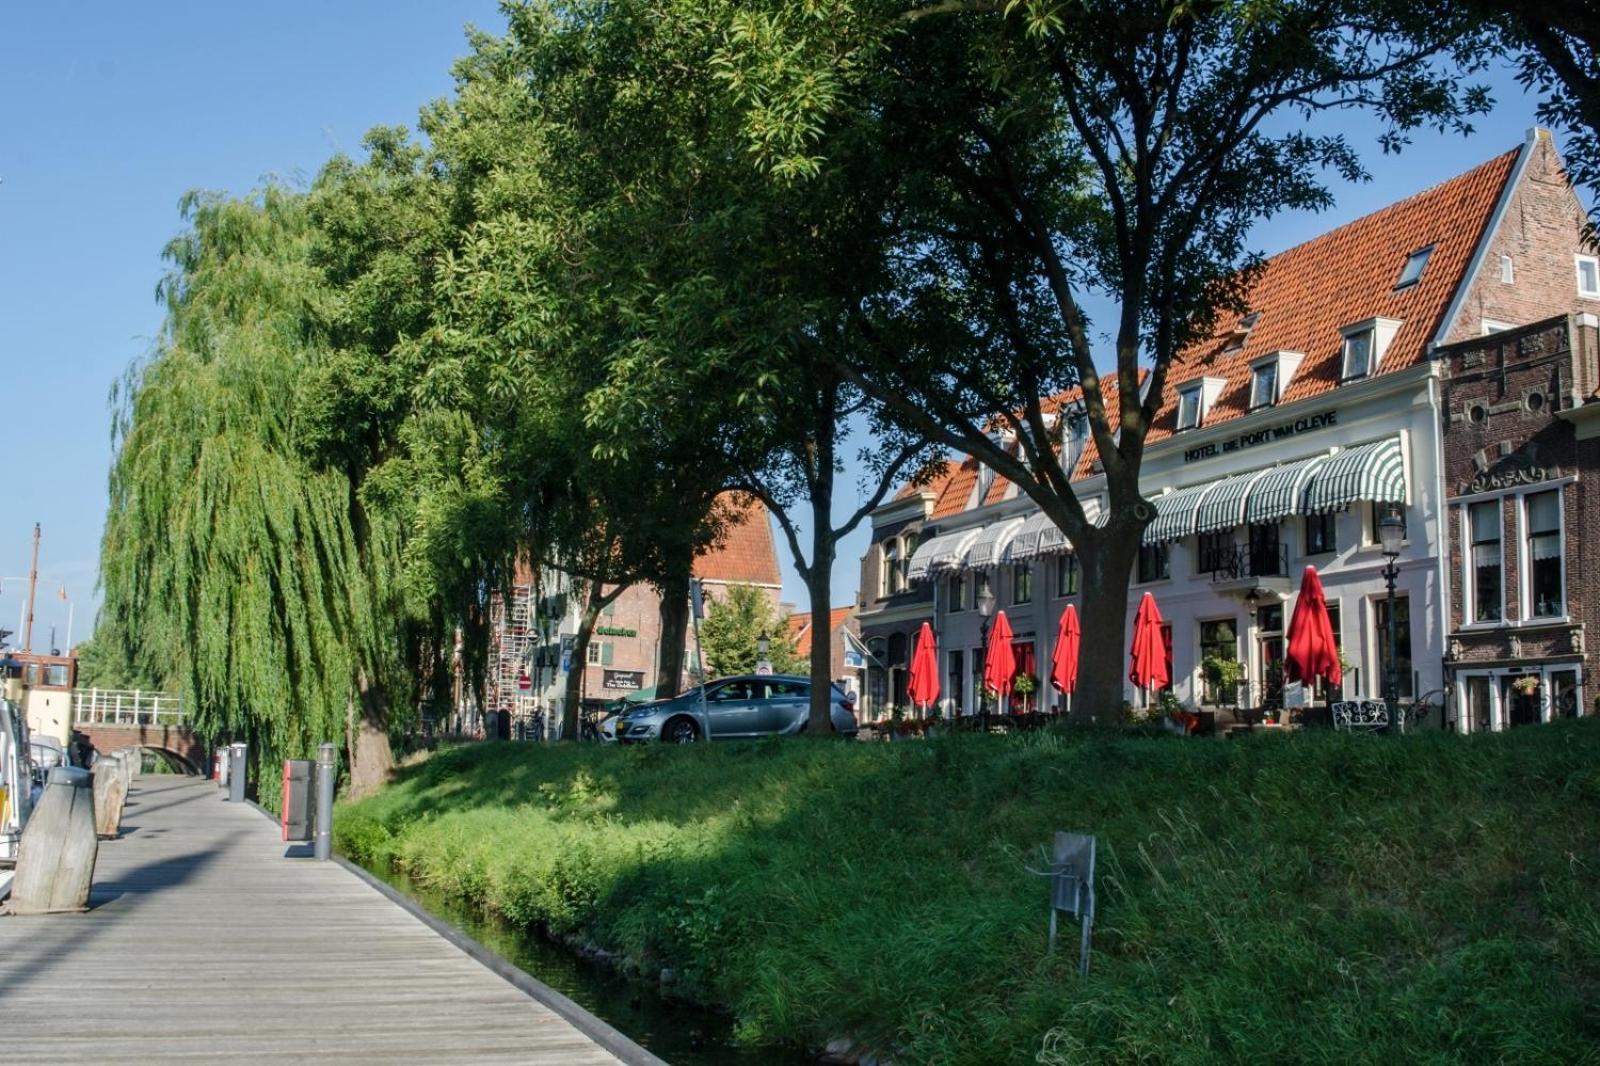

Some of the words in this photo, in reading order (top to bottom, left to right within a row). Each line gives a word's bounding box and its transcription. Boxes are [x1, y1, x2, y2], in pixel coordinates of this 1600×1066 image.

[1184, 444, 1219, 462] HOTEL
[1240, 429, 1271, 448] PORT
[1295, 410, 1337, 433] CLEVE
